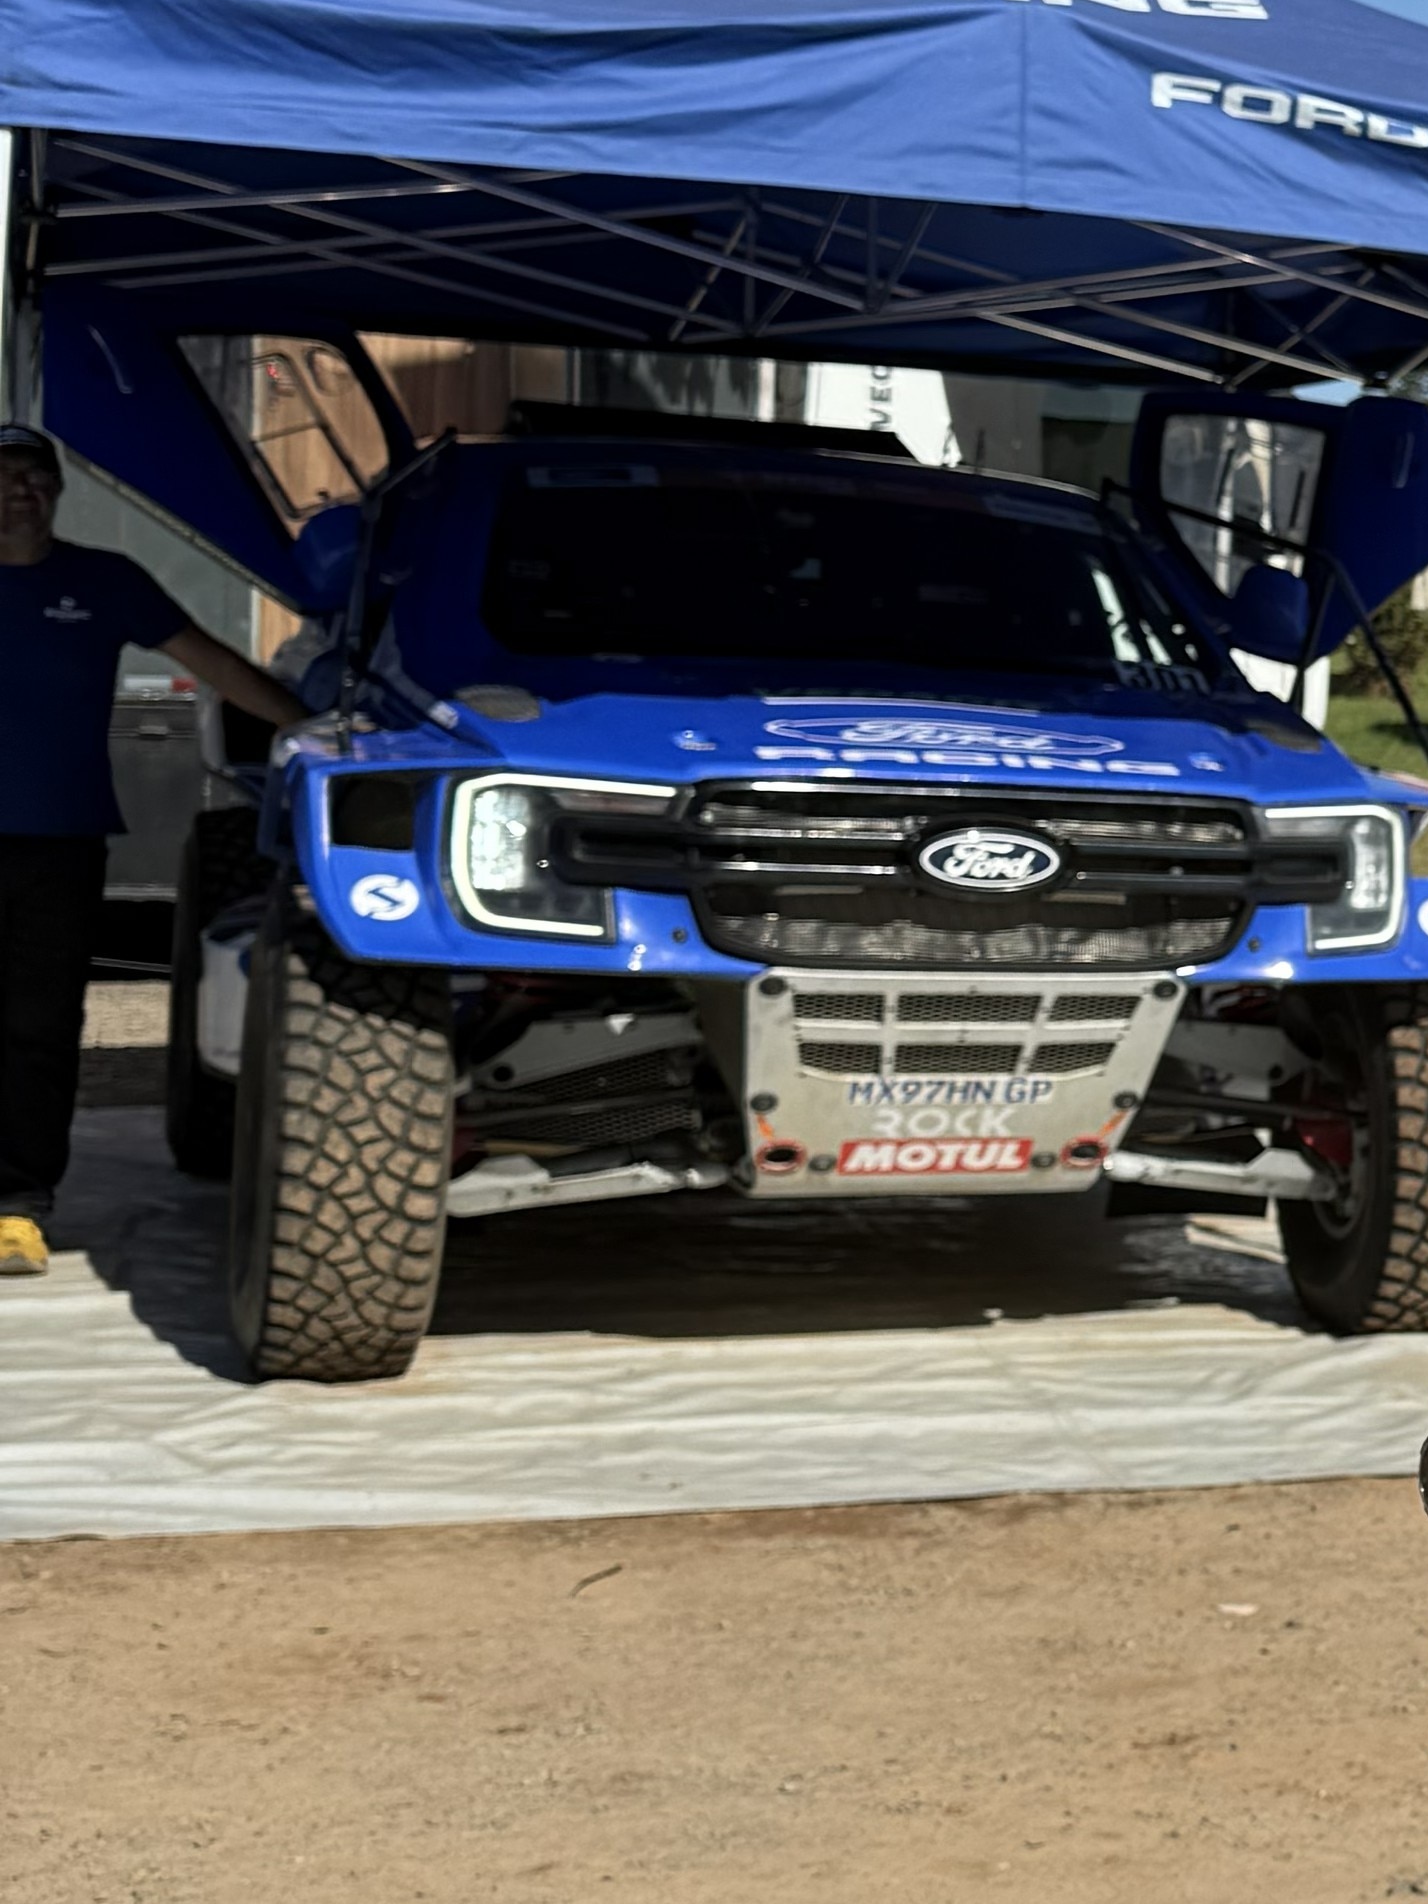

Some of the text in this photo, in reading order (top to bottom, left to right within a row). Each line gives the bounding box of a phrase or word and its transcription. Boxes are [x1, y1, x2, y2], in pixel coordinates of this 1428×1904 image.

[840, 719, 1055, 752] Ford
[943, 841, 1034, 880] Ford
[871, 1107, 1016, 1138] ROCK
[843, 1140, 1024, 1172] MOTUL
